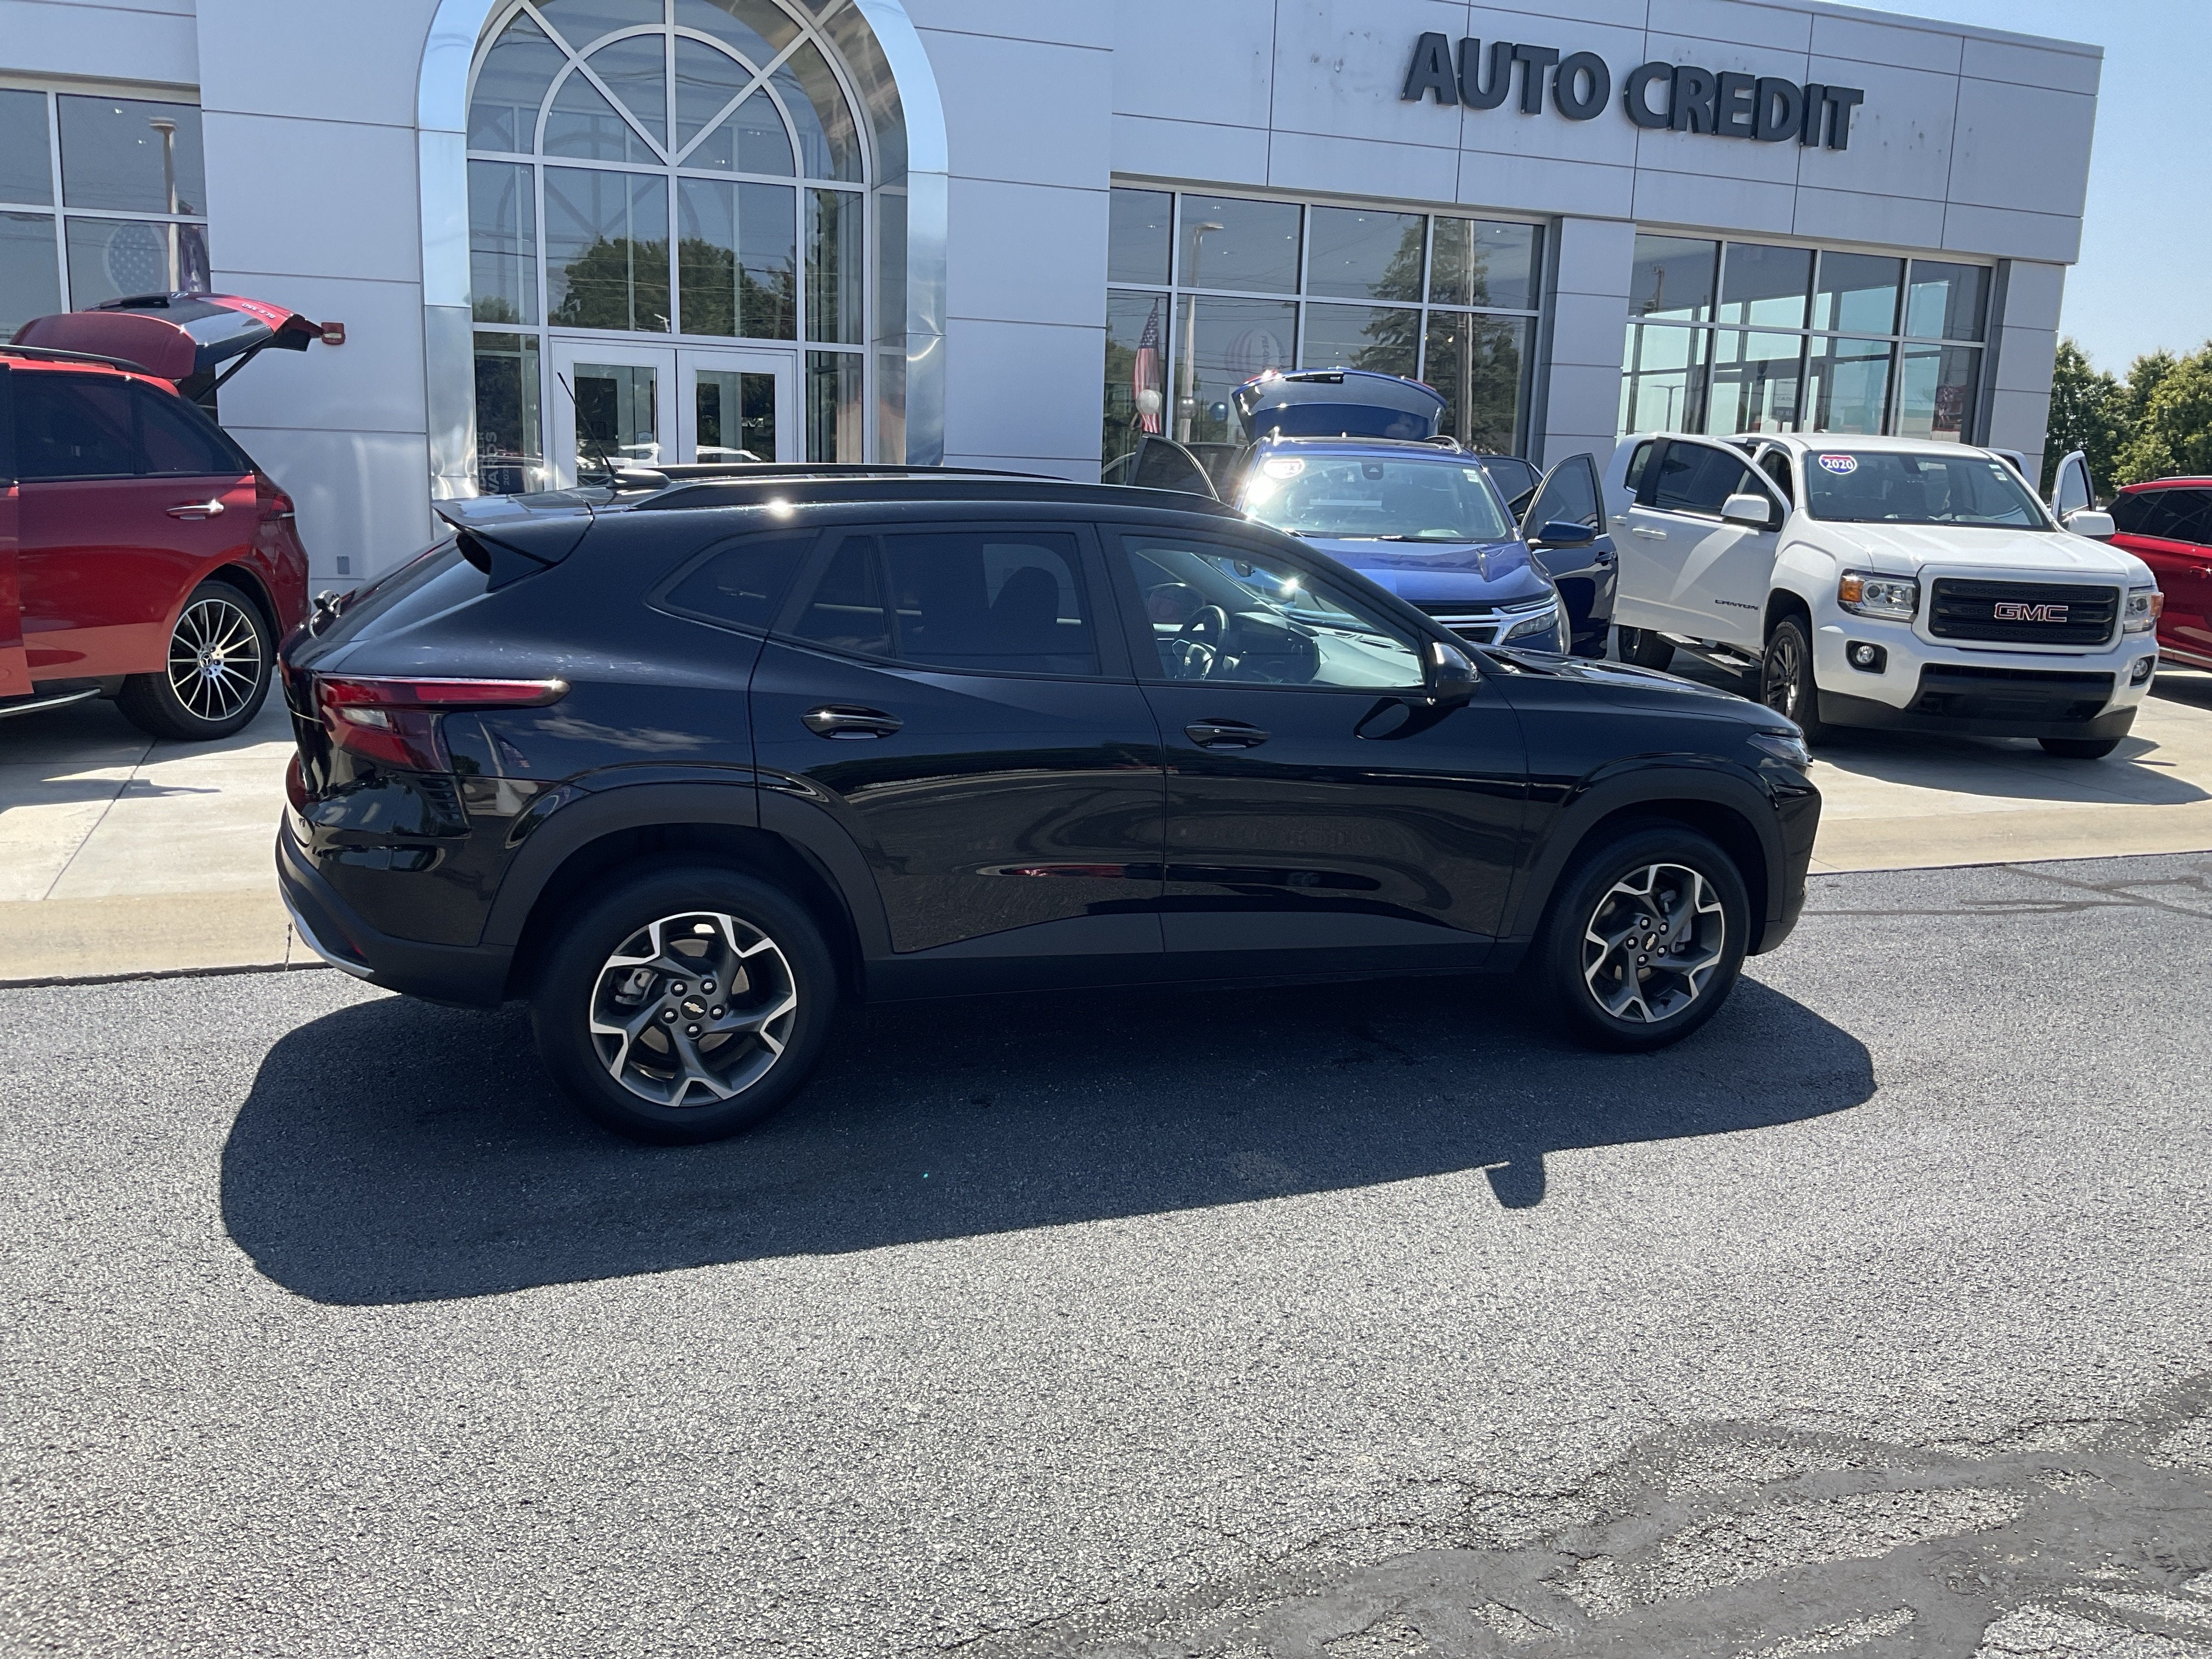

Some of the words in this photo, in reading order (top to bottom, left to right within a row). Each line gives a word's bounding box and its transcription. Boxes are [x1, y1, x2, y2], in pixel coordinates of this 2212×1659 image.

[1401, 31, 1611, 121] AUTO
[1624, 61, 1865, 151] CREDIT
[258, 309, 276, 319] GLE
[1824, 459, 1854, 470] 2020
[1715, 599, 1759, 611] CANYON
[1994, 602, 2068, 622] GMC
